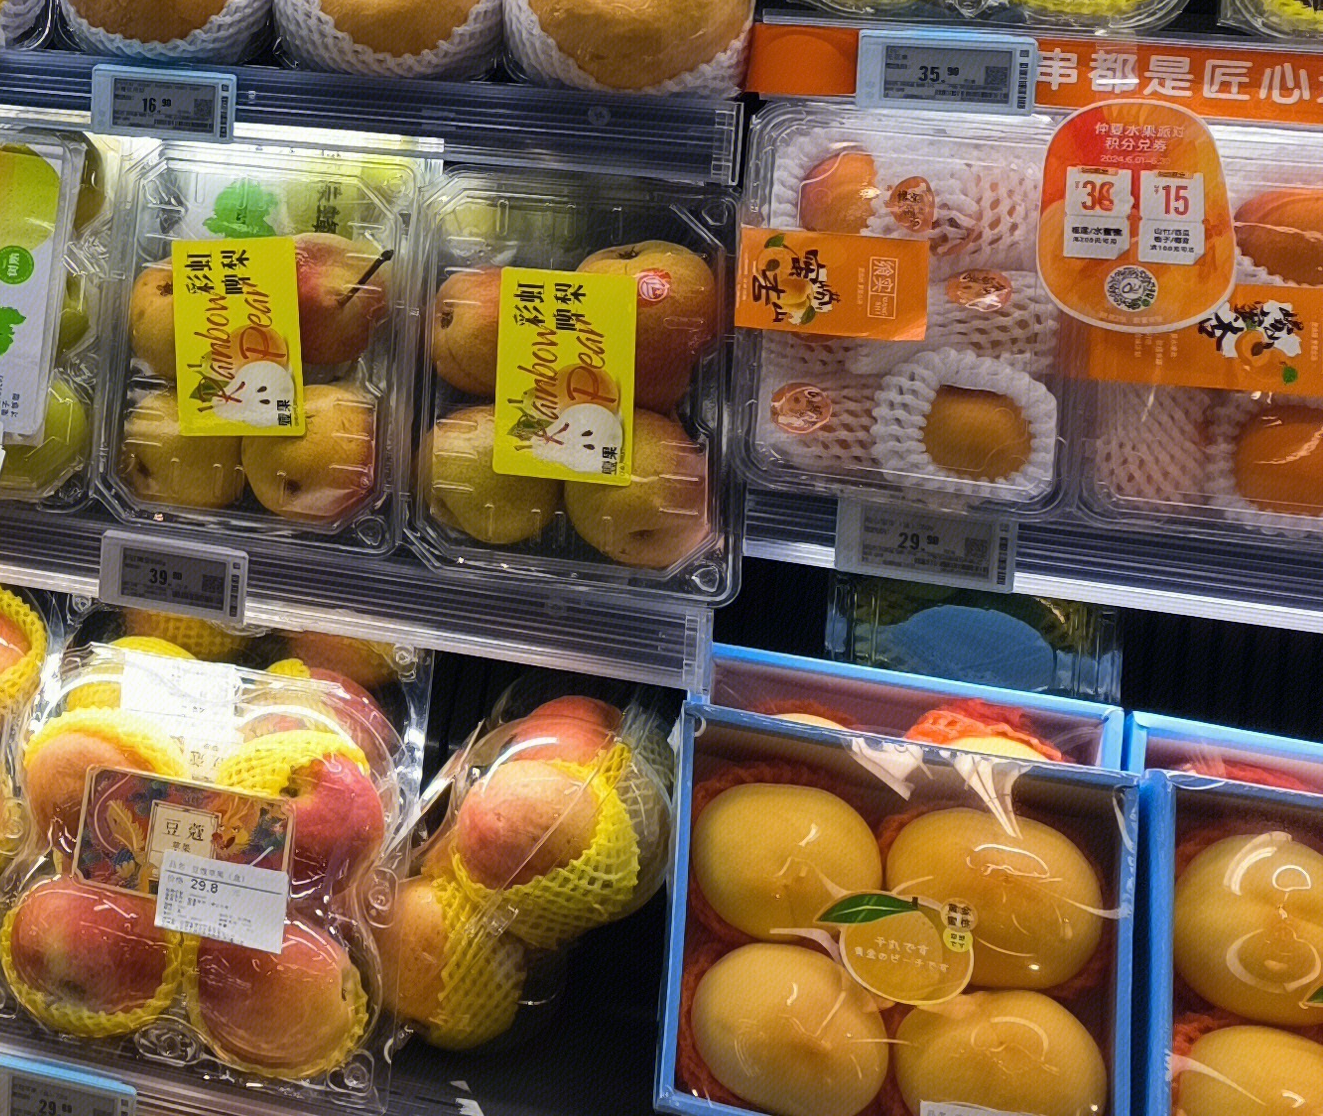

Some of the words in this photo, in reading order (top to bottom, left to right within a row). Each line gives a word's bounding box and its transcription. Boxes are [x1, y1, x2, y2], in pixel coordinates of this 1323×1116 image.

[1037, 46, 1323, 106] 串都是匠心
[1094, 121, 1186, 139] 仲夏水果派对
[1104, 137, 1168, 152] 积分兑券
[1162, 185, 1190, 216] 15
[6, 252, 21, 277] 树熟
[184, 250, 215, 296] 彩虹
[513, 282, 546, 327] 彩虹
[238, 281, 287, 360] Pear
[565, 318, 617, 405] Pear
[161, 819, 206, 841] 豆蔻
[171, 841, 192, 854] 苹果
[190, 878, 219, 895] 29.8
